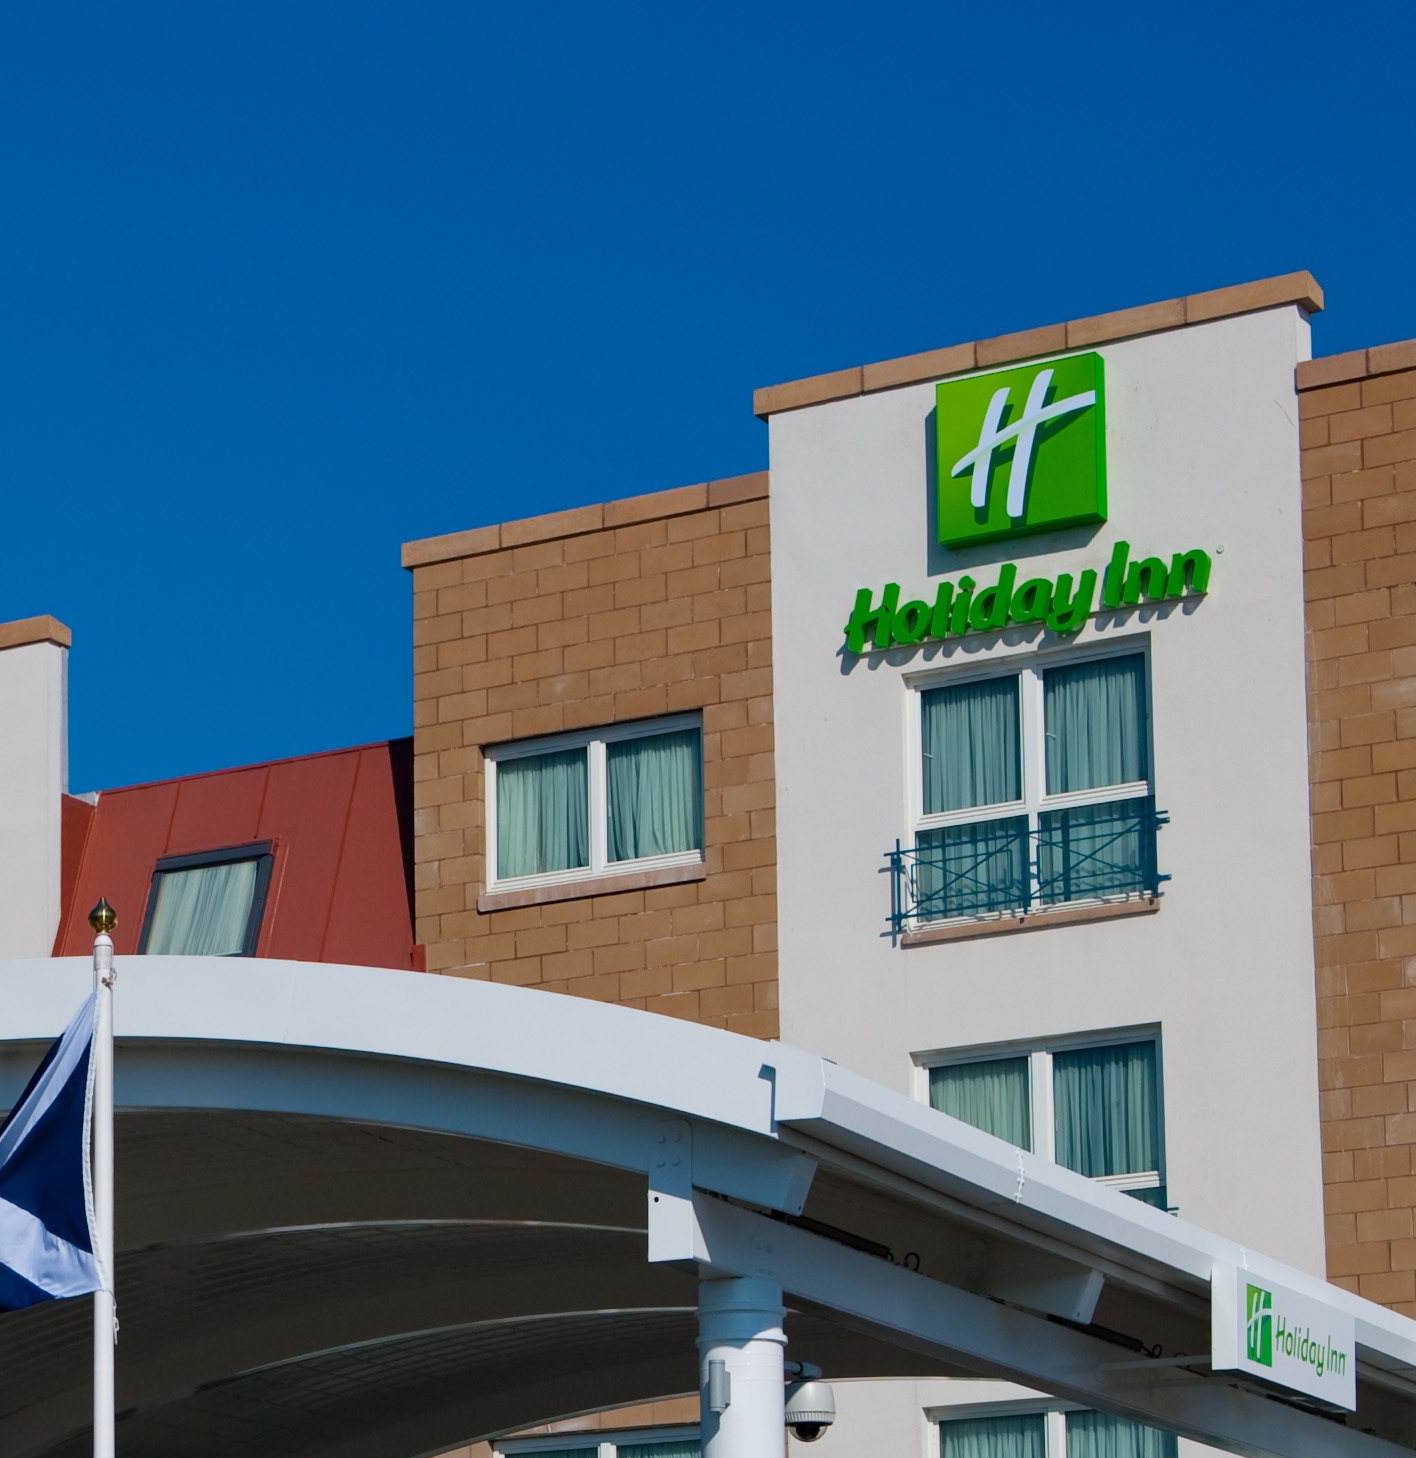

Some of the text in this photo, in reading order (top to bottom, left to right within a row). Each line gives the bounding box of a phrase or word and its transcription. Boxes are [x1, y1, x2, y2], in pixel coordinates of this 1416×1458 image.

[844, 540, 1212, 654] Holiday Inn
[1275, 1314, 1347, 1378] Holiday Inn
